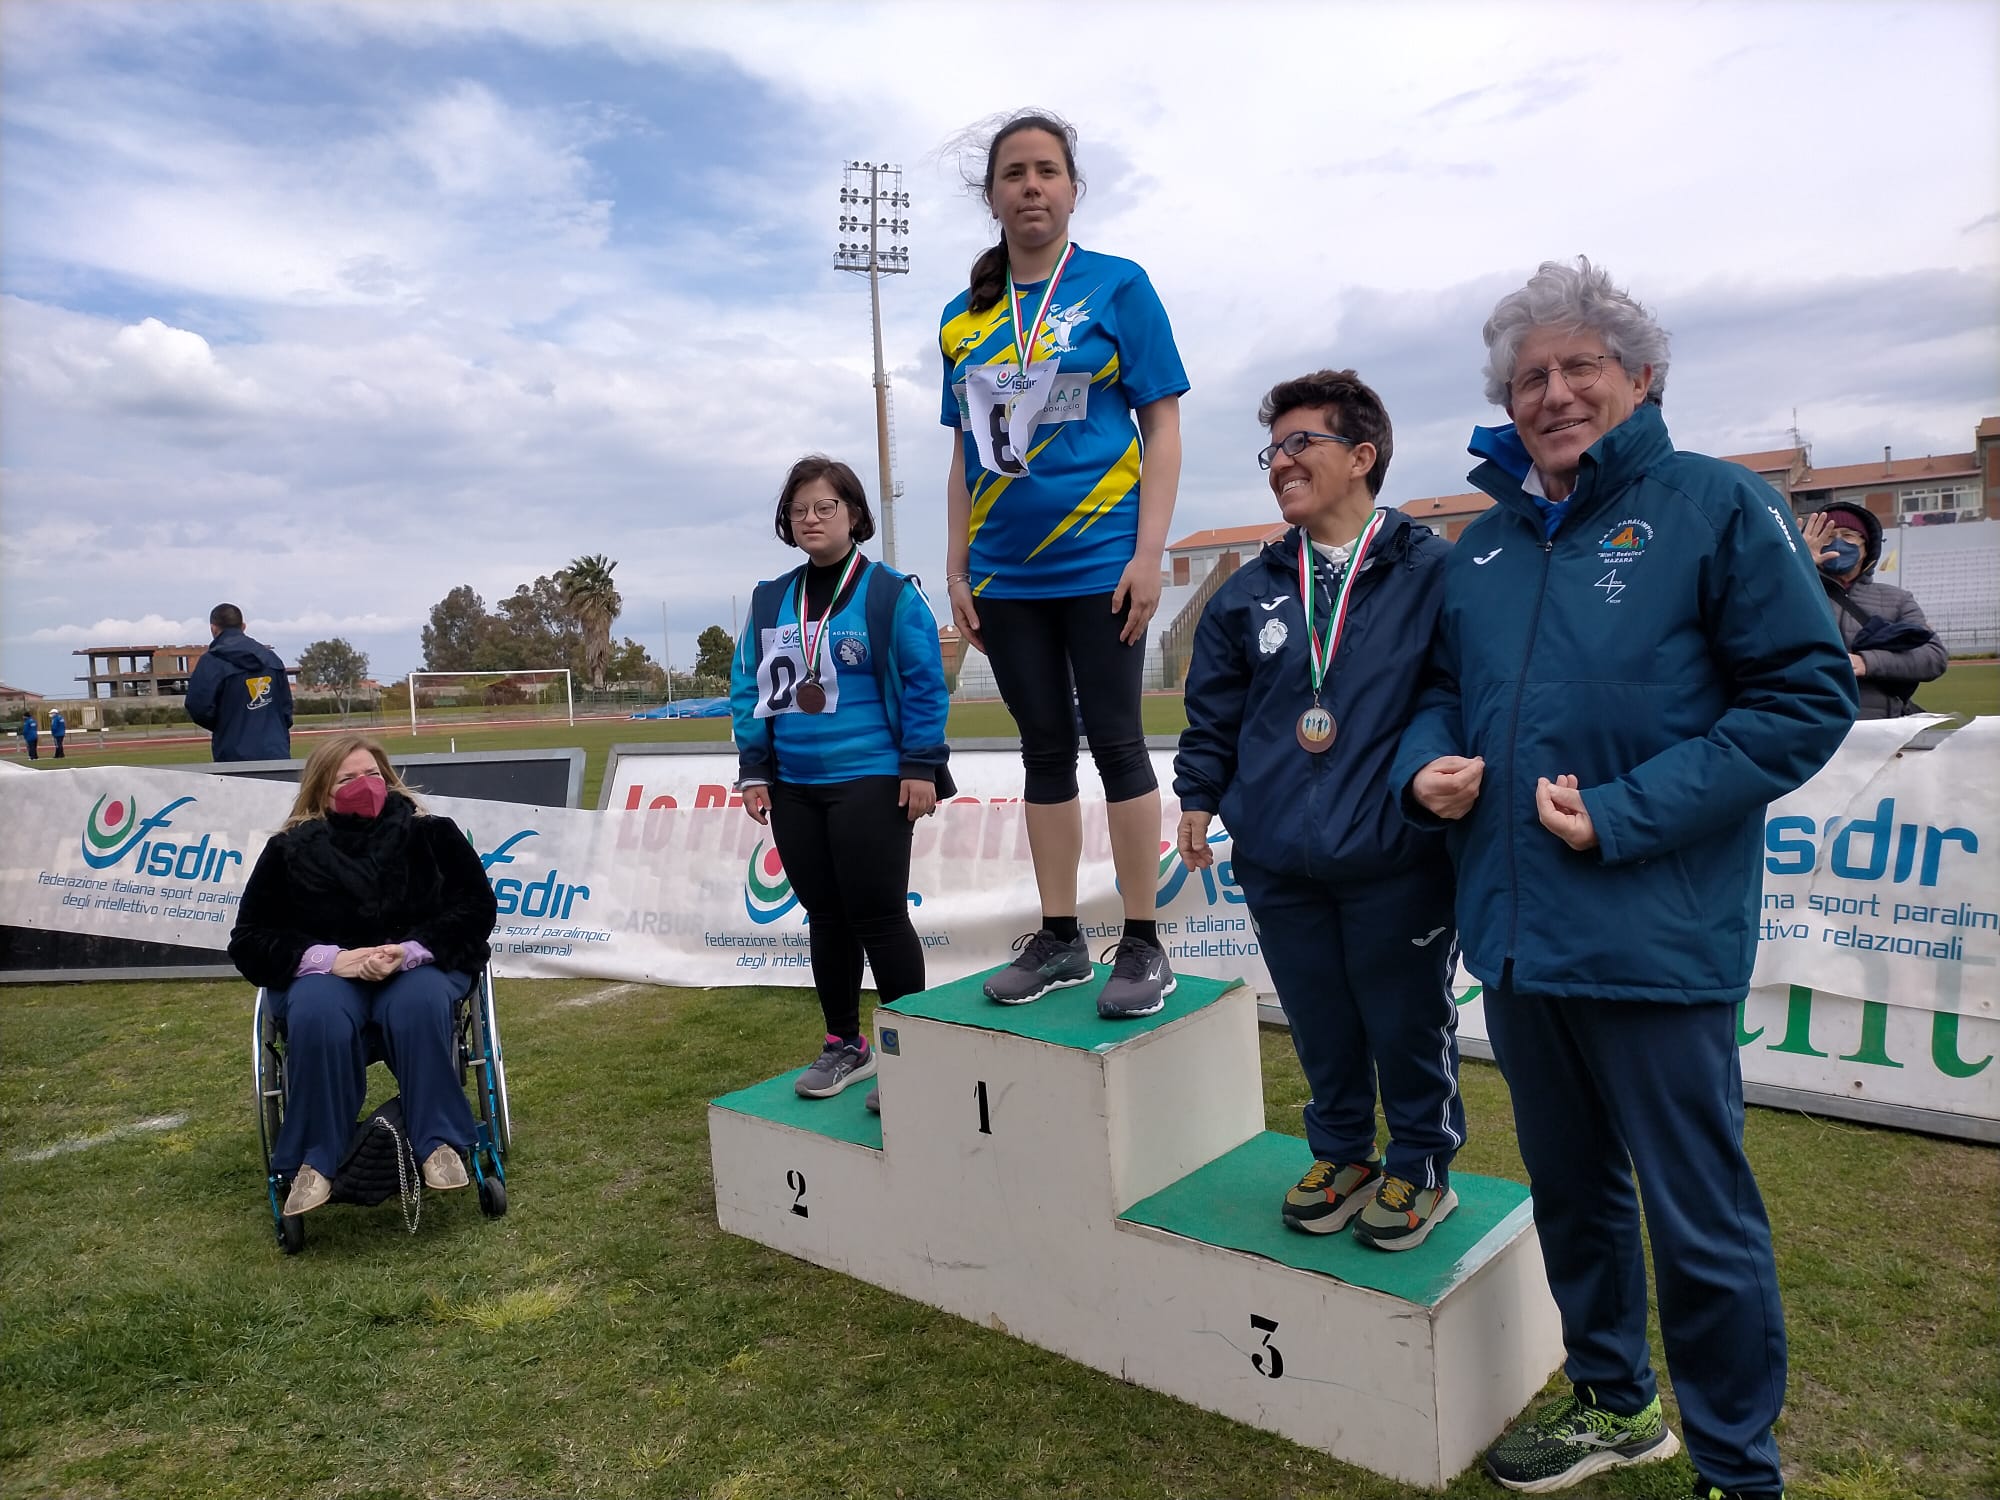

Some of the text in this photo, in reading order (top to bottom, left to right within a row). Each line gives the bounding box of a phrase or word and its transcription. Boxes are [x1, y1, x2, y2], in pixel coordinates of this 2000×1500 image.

[1043, 403, 1080, 413] DOMICILIO
[38, 871, 242, 906] federazione italiana sport paralim
[62, 892, 92, 910] degli
[95, 895, 158, 916] intellettivo
[164, 905, 226, 924] relazionali
[1808, 893, 1881, 918] sport
[1893, 902, 2000, 936] paralim
[505, 924, 540, 937] sport
[541, 926, 614, 943] paralimpici
[1185, 915, 1247, 933] italiana
[508, 940, 573, 957] relazionali
[705, 932, 811, 948] federazione italia
[1168, 938, 1259, 959] intellettivo
[1822, 927, 1963, 961] relazionali
[736, 952, 768, 969] degli
[973, 1080, 992, 1135] 1
[786, 1169, 809, 1218] 2
[1250, 1313, 1284, 1379] 3
